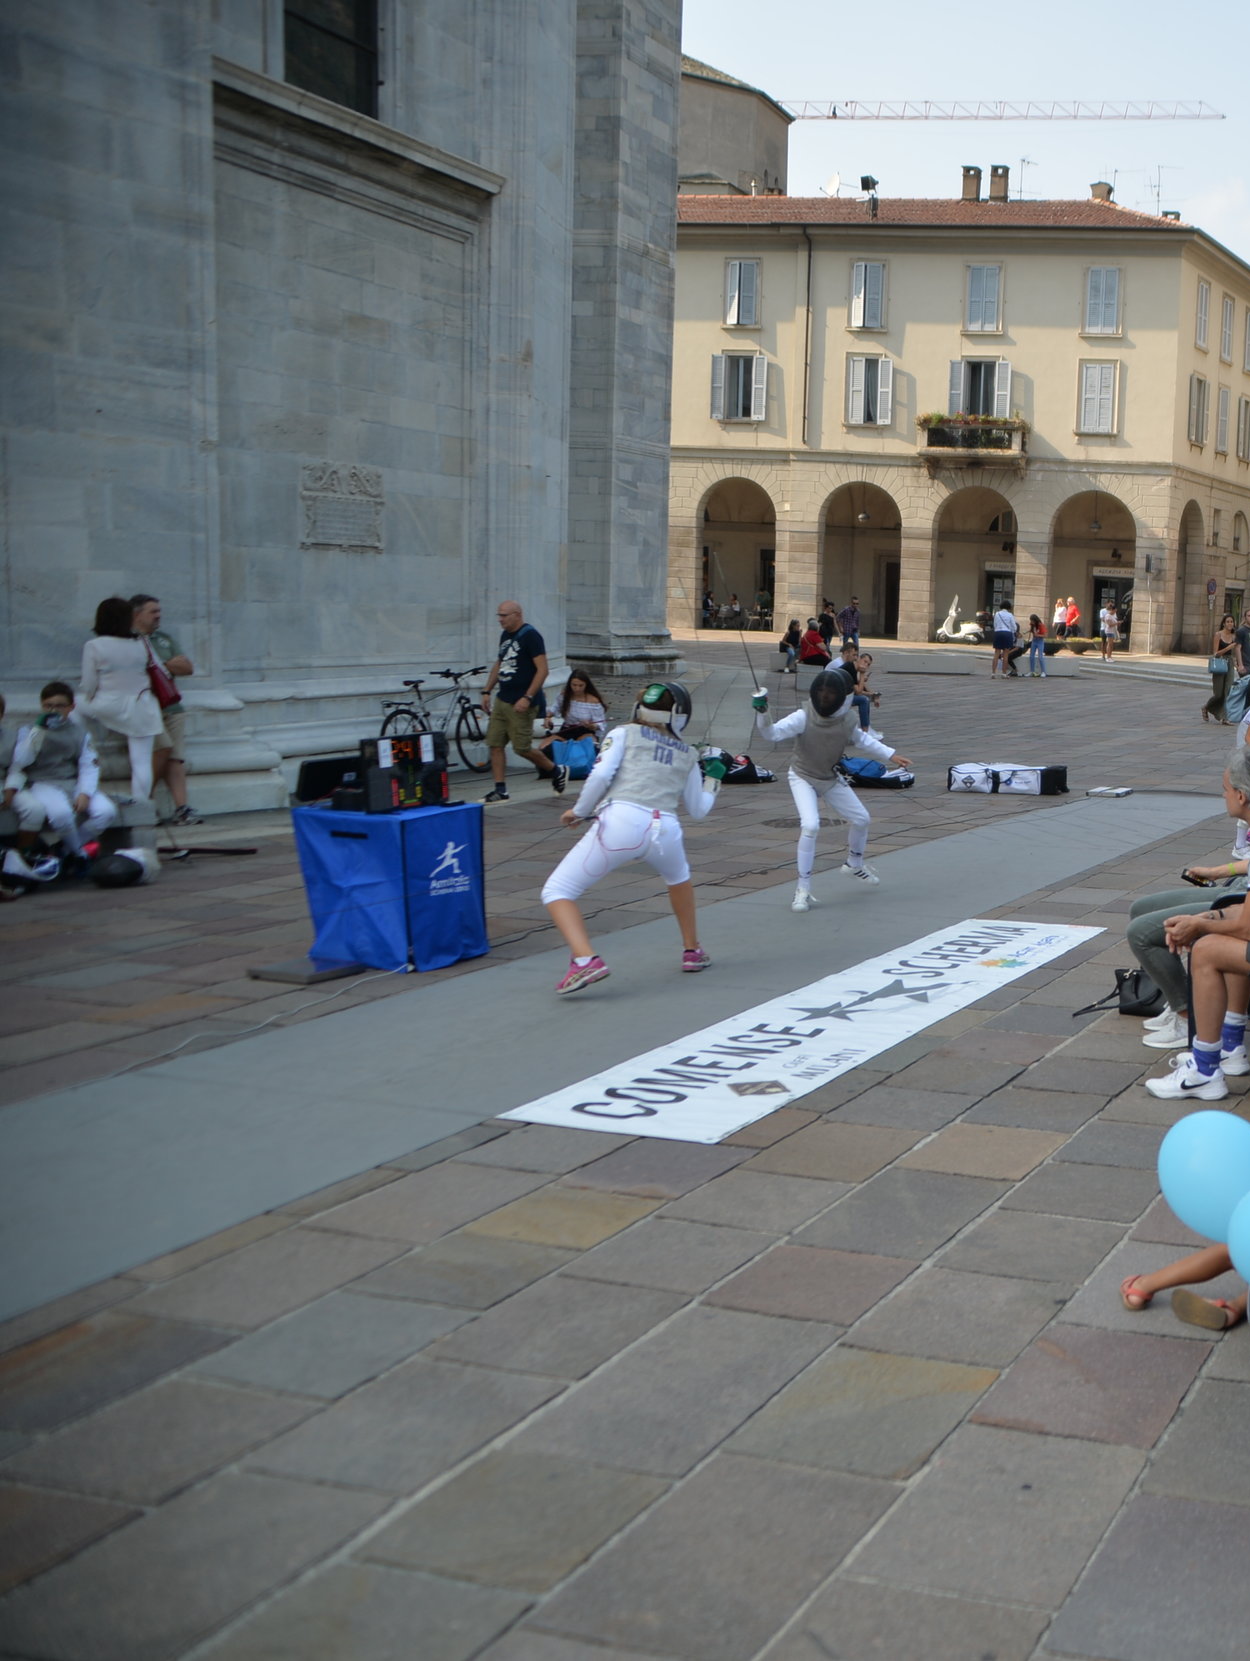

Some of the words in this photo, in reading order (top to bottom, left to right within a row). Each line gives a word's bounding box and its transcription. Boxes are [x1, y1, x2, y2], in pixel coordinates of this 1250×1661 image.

[654, 744, 673, 766] ITA
[571, 1023, 826, 1119] COMENSE
[882, 925, 1037, 978] SCHERMA
[790, 1048, 867, 1080] MILANI
